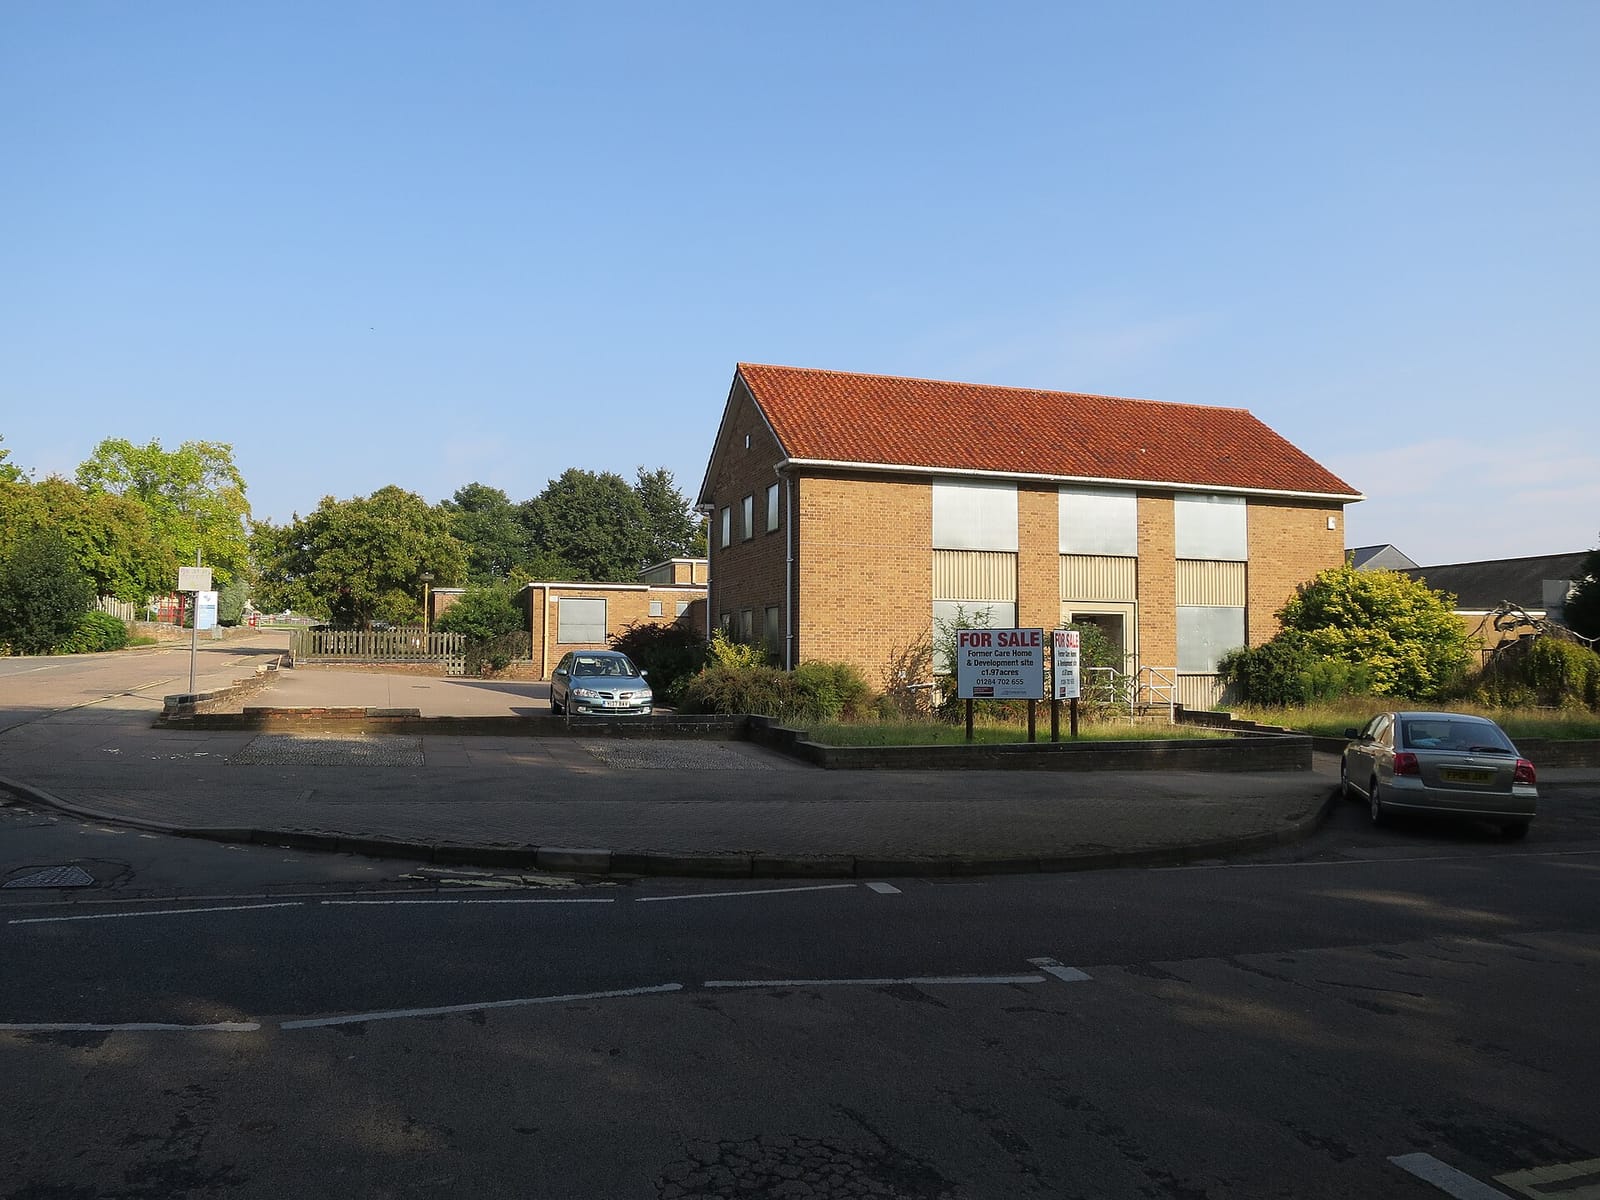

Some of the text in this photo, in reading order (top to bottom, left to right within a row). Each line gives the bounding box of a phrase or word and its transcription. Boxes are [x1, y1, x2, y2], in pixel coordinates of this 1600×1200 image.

[960, 631, 1040, 648] FOR SALE
[1055, 633, 1079, 648] FOR SALE
